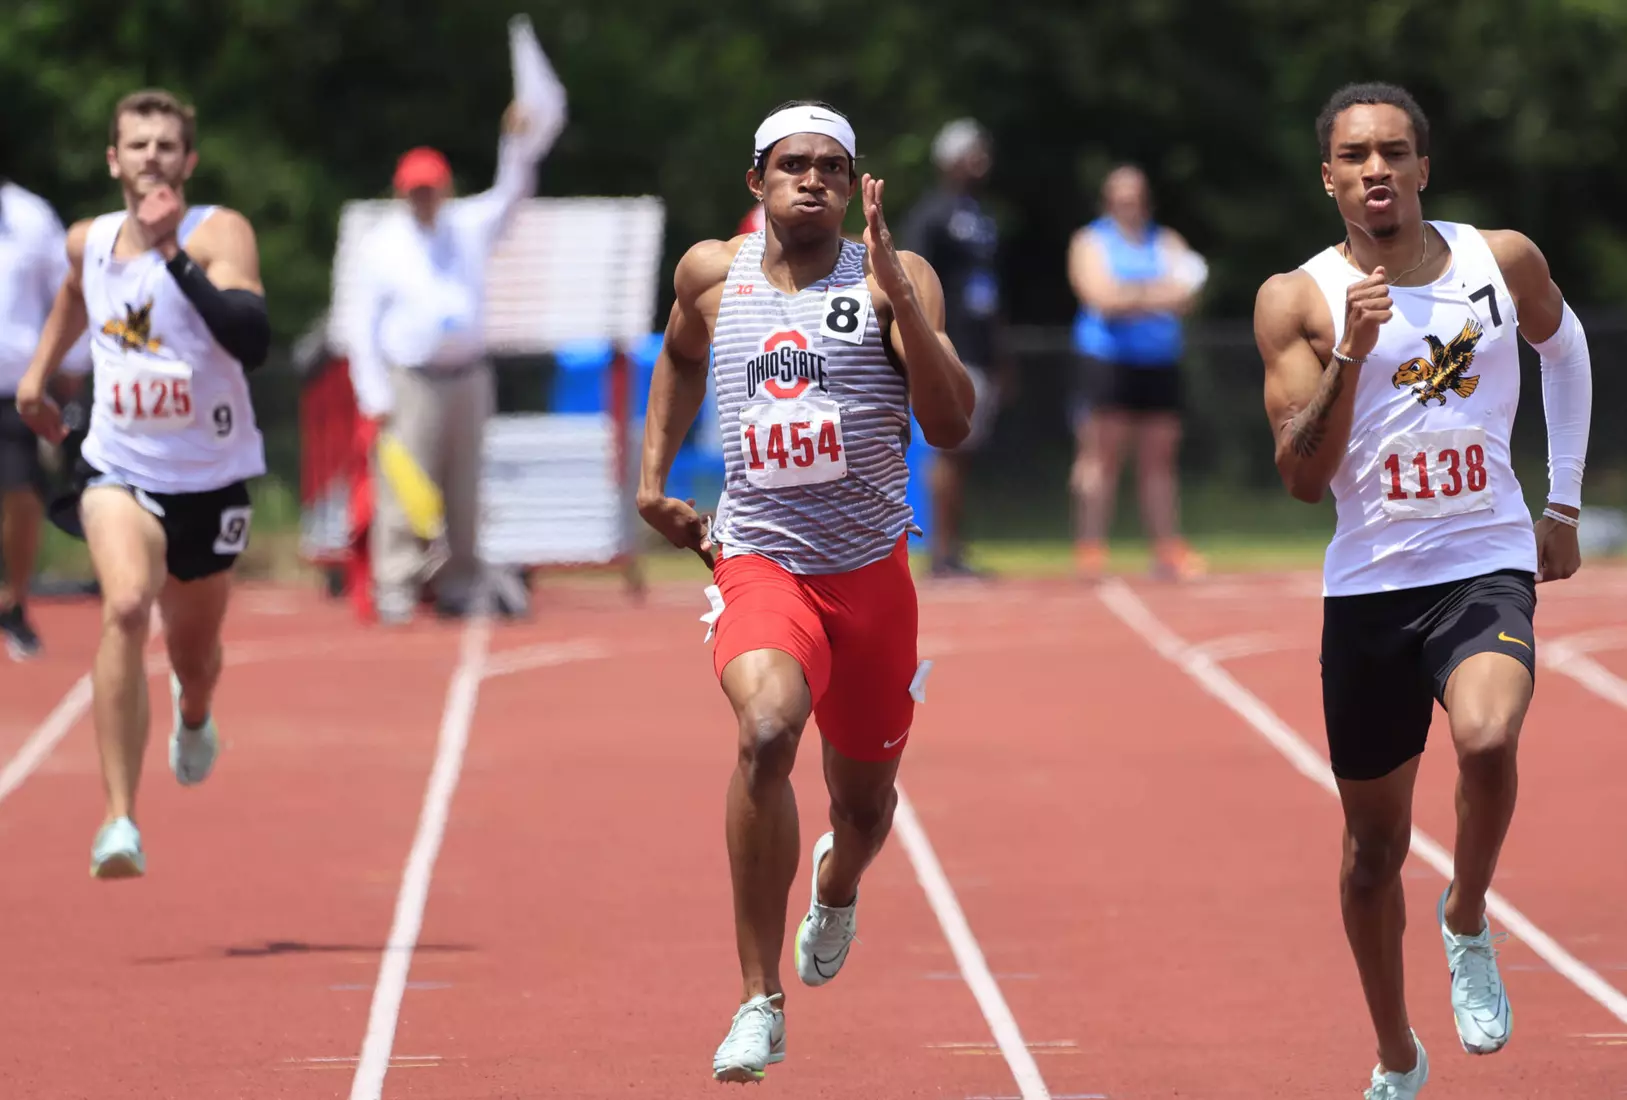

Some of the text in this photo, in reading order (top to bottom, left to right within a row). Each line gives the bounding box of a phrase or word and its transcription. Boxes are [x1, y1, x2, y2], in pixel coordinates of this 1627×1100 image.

[826, 296, 861, 333] 8
[1467, 283, 1503, 328] 7
[112, 378, 191, 420] 1125
[212, 404, 233, 437] 9
[744, 419, 842, 470] 1454
[1384, 444, 1487, 500] 1138
